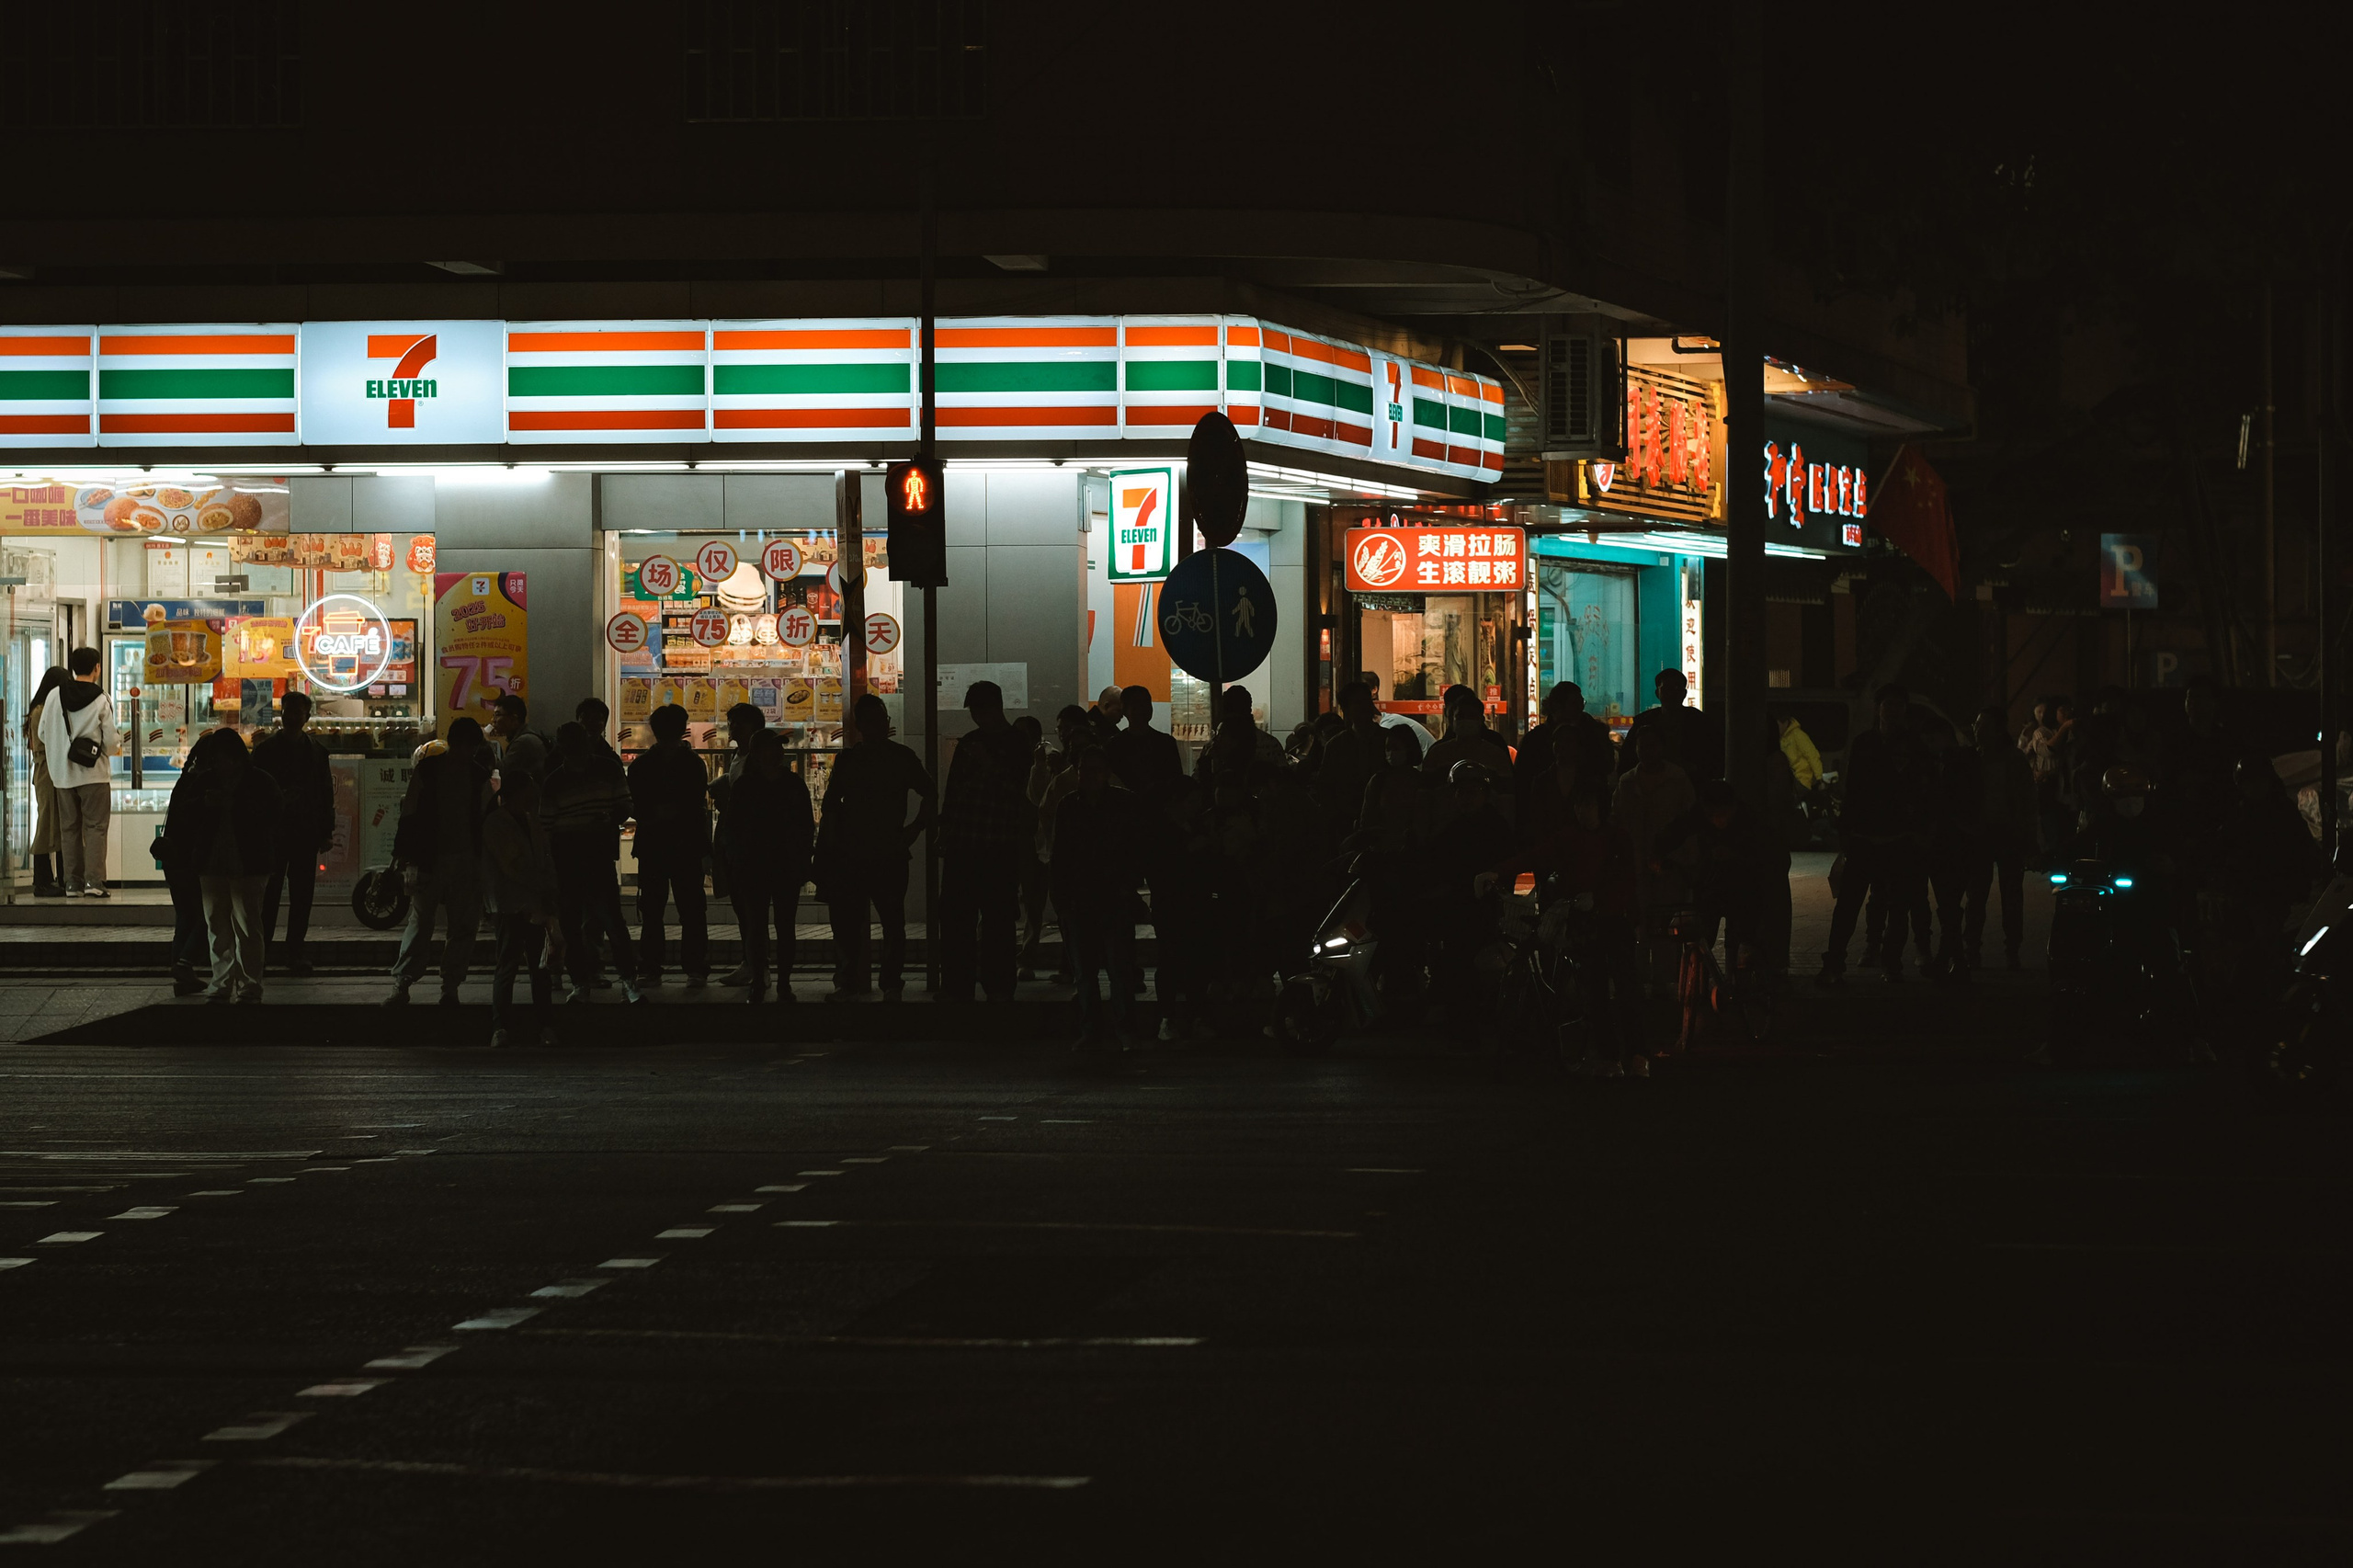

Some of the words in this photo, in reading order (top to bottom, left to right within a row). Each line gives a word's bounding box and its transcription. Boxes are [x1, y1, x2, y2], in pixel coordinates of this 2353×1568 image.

[368, 335, 437, 428] 7
[1386, 361, 1402, 449] 7
[6, 508, 77, 528] 一番美味
[1122, 487, 1157, 570] 7
[1416, 534, 1517, 558] 爽滑拉肠
[705, 550, 729, 574] 仅
[770, 549, 794, 573] 限
[1416, 561, 1517, 585] 生滚靓粥
[2110, 544, 2143, 597] P
[648, 563, 672, 588] 场
[509, 585, 524, 594] 今天
[451, 600, 487, 622] 2025
[614, 619, 640, 643] 全
[695, 619, 726, 641] 7.5
[786, 614, 810, 639] 折
[868, 621, 892, 645] 天
[2156, 652, 2178, 683] P
[440, 655, 517, 710] 75
[510, 677, 521, 689] 折
